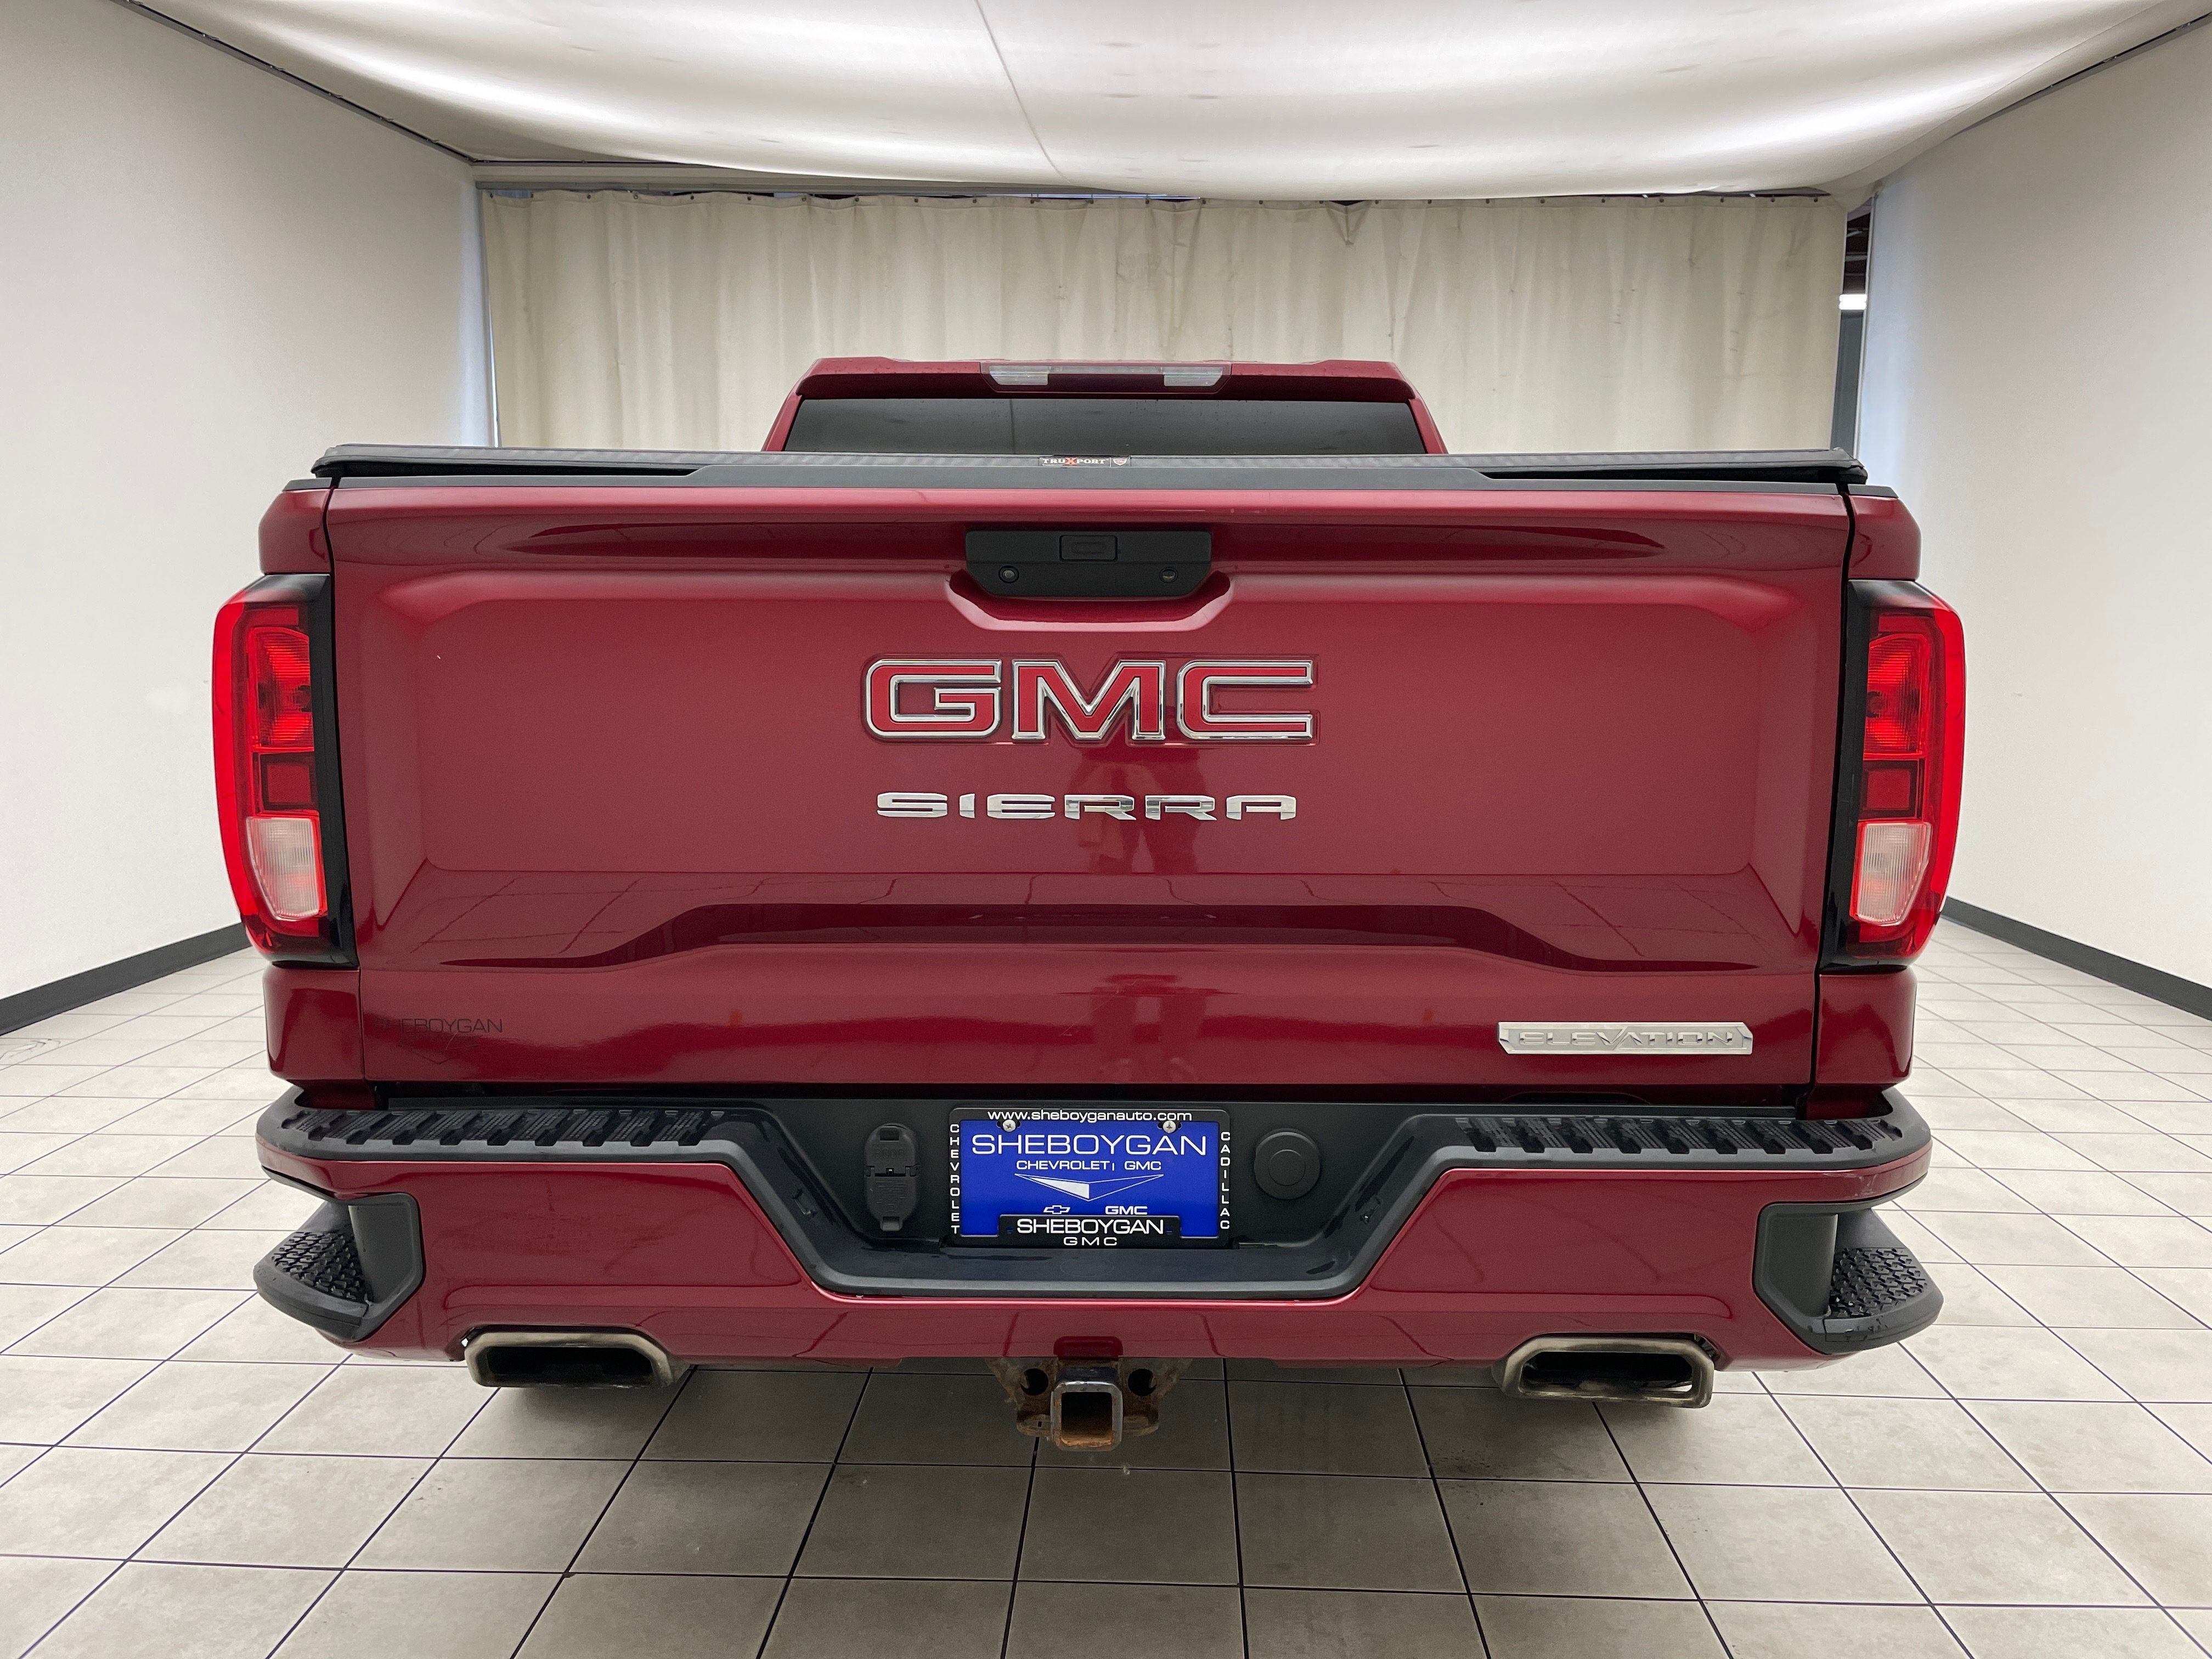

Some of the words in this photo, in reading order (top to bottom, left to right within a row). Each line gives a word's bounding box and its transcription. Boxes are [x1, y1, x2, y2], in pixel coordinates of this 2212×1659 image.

[866, 658, 1314, 740] GMC
[877, 792, 1297, 821] SIERRA
[1519, 1026, 1734, 1046] ELEVATION
[987, 1108, 1193, 1123] www.sheboyganauto.com
[972, 1133, 1206, 1156] SHEBOYGAN
[1016, 1160, 1110, 1171] CHEVROLET
[1124, 1160, 1161, 1171] GMC
[950, 1124, 960, 1235] CHEVROLET
[1220, 1131, 1231, 1230] CADILLAC
[1104, 1205, 1148, 1215] GMC
[1016, 1218, 1164, 1235] SHEBOYGAN
[1063, 1237, 1118, 1246] GMC
